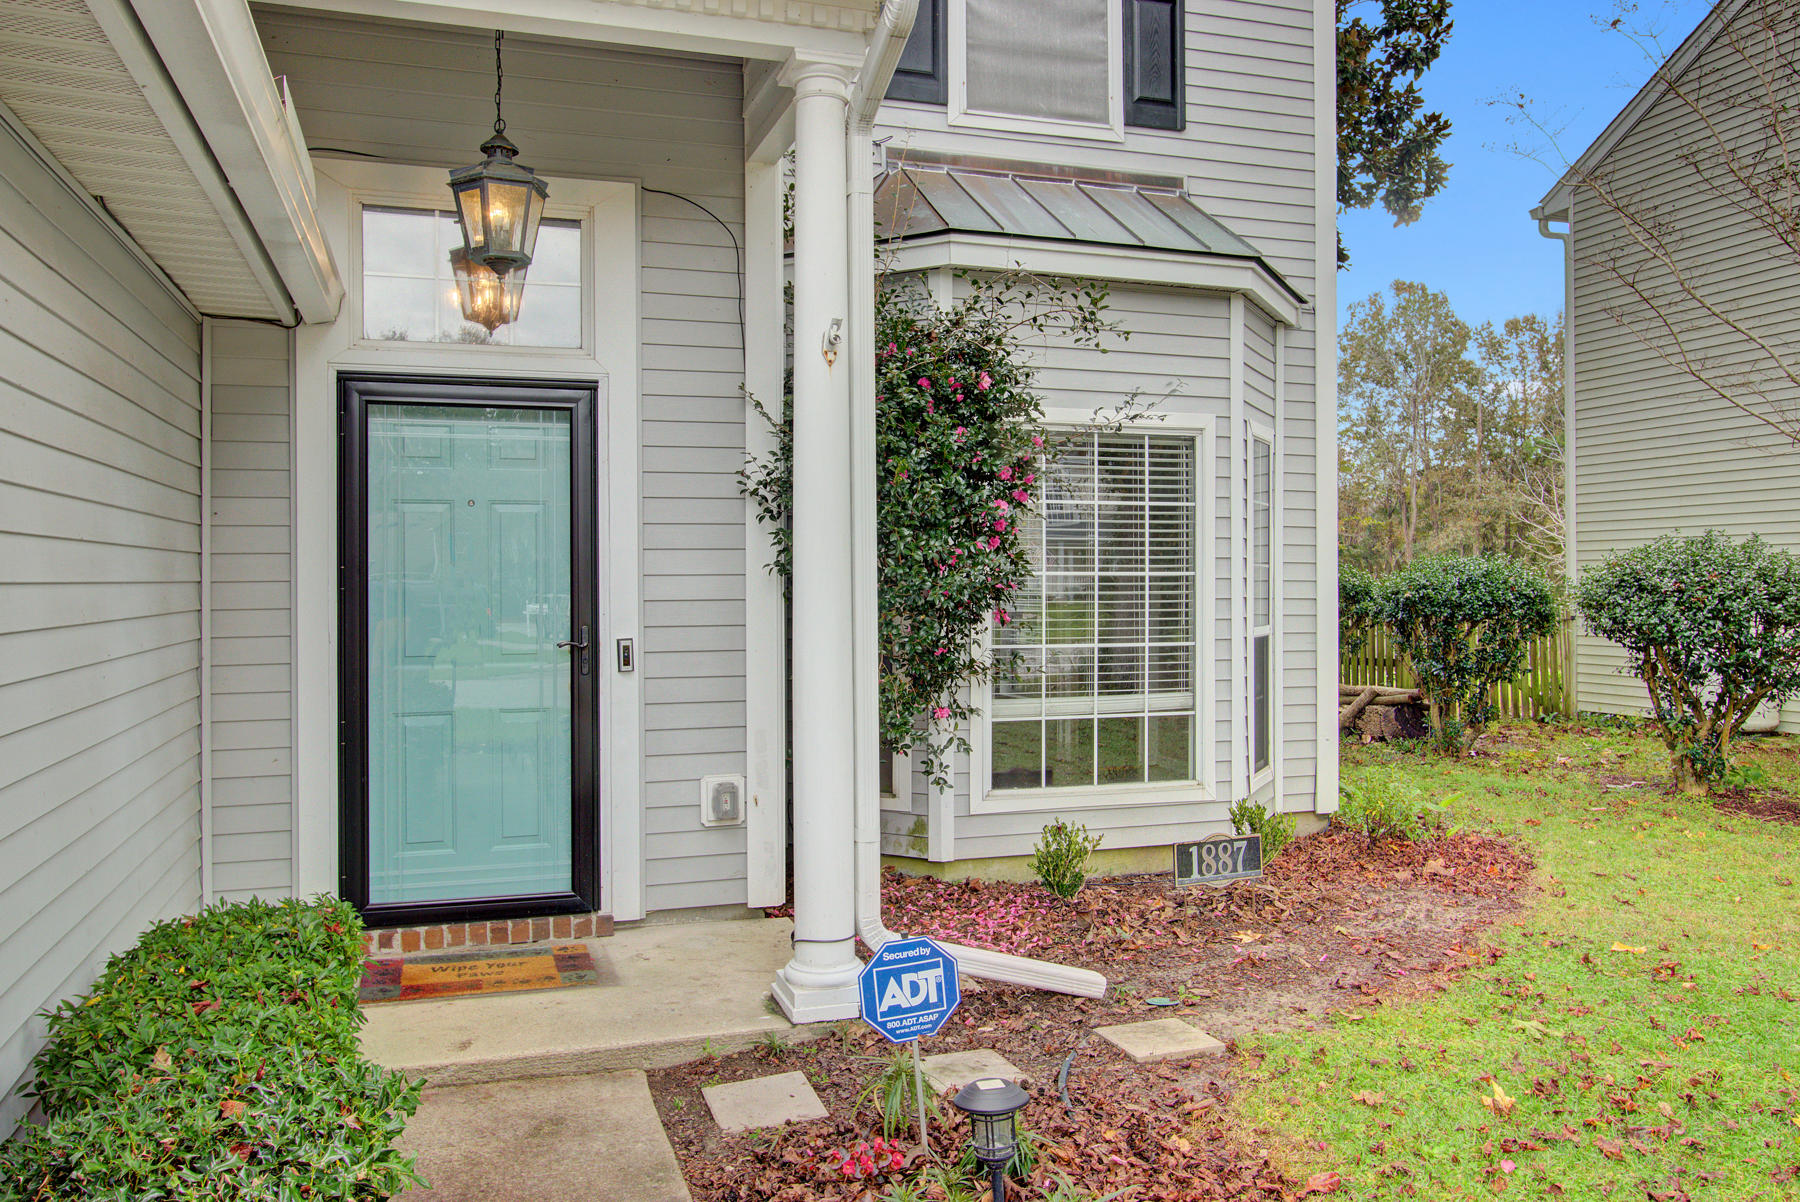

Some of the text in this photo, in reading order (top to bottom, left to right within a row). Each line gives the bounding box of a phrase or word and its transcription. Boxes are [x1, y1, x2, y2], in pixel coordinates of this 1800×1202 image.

[1189, 841, 1247, 879] 1887
[882, 947, 931, 961] Secured by
[880, 967, 942, 1012] ADT
[886, 1013, 939, 1029] 800.ADT.ASAP
[895, 1023, 933, 1034] www.ADT.com
